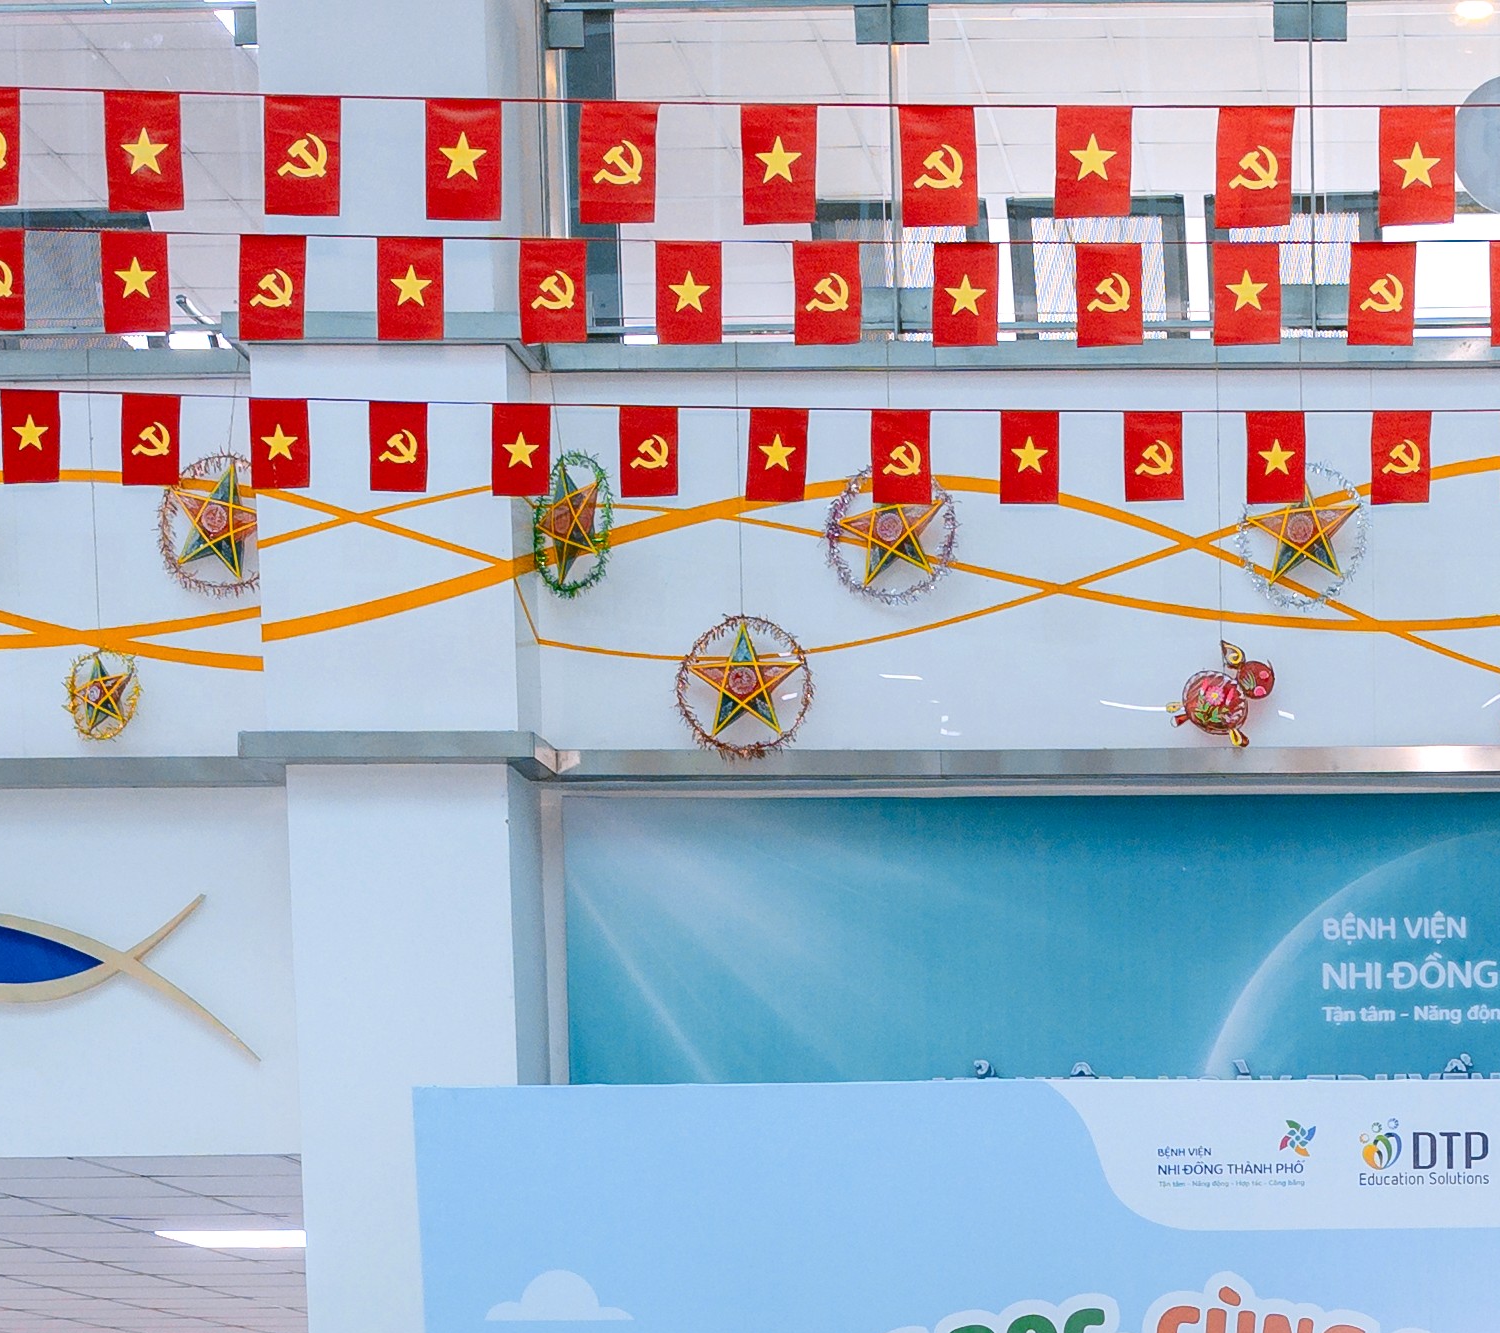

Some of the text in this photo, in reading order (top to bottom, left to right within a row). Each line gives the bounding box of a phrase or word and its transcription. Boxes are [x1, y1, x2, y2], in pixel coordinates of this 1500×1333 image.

[1322, 910, 1467, 945] BỆNH VIỆN
[1322, 961, 1382, 990] NHI
[1385, 951, 1499, 990] ĐỒNG
[1322, 1006, 1355, 1025] Tận
[1359, 1005, 1396, 1023] tâm
[1413, 1004, 1462, 1024] Năng
[1157, 1145, 1212, 1160] BỆNH VIỆN
[1412, 1131, 1489, 1170] DTP
[1157, 1159, 1306, 1176] NHI ĐỒNG THÀNH PHỐ
[1359, 1171, 1490, 1186] Education Solutions
